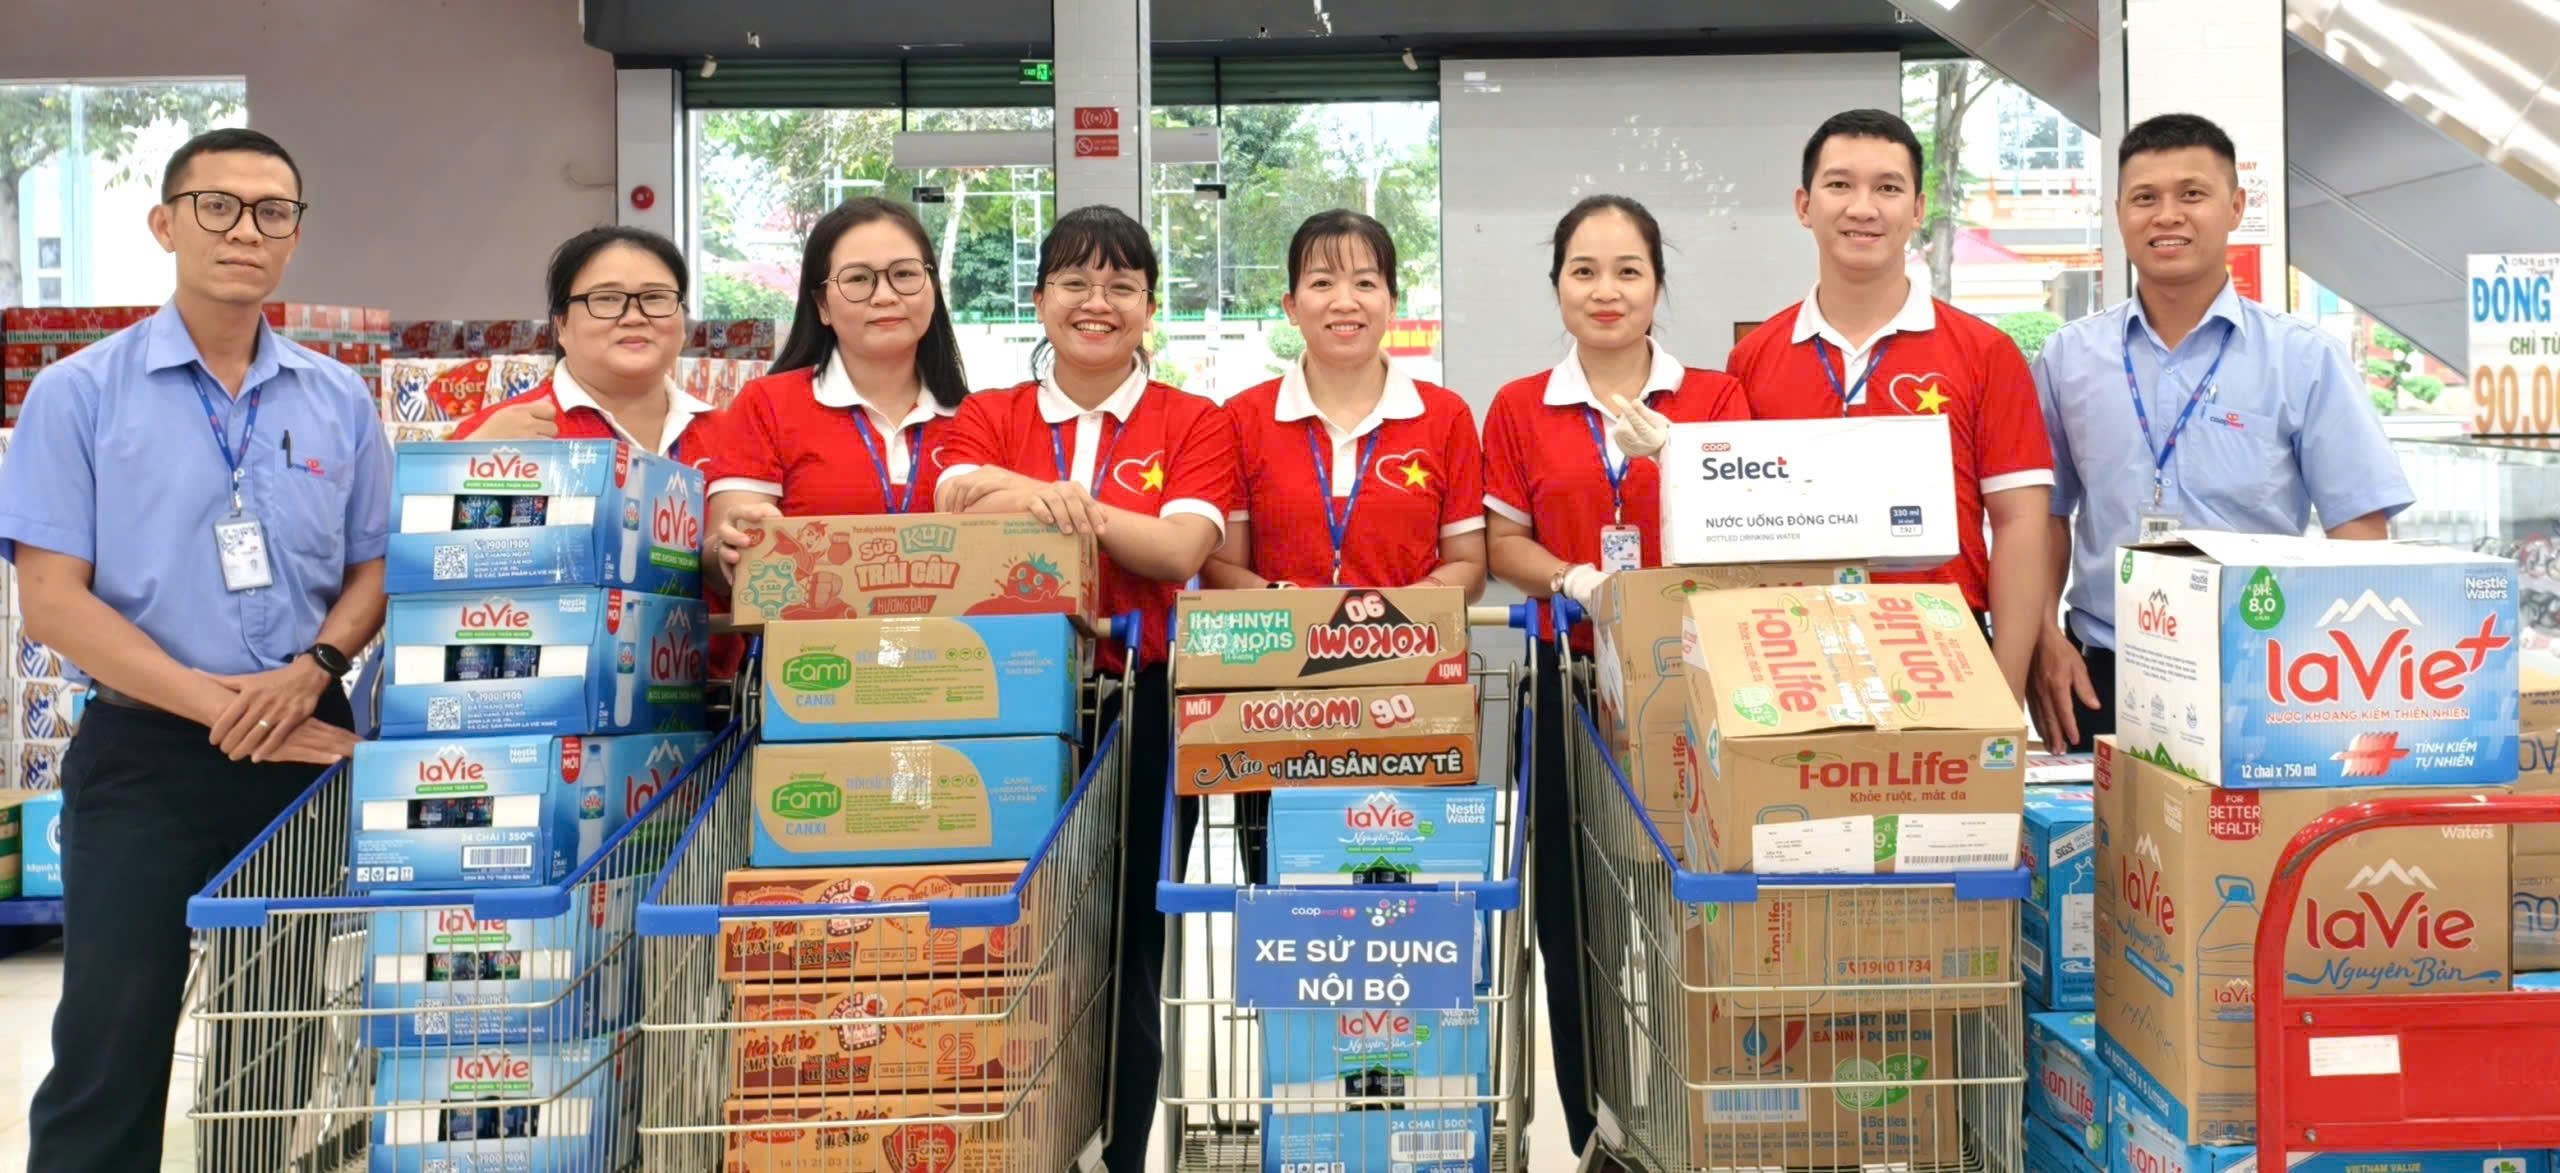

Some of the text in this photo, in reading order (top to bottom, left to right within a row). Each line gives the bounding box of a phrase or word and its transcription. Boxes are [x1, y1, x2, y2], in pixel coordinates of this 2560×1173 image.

[2472, 256, 2551, 323] ĐỒNG
[437, 377, 484, 400] Tiger
[2475, 364, 2560, 434] 90.0
[469, 452, 539, 479] laVie
[1702, 456, 1790, 481] Select
[652, 495, 698, 550] laVie
[1828, 513, 1858, 525] CHAI
[855, 555, 960, 591] TRÁI CÂY
[2465, 576, 2508, 589] Nestlé
[1345, 592, 1386, 622] 90
[2249, 597, 2277, 616] 8,0
[2465, 588, 2508, 601] Waters
[460, 602, 529, 629] laVie
[2138, 601, 2177, 637] laVie
[1308, 623, 1439, 658] KOKOMI
[795, 694, 836, 707] CANXI
[1240, 694, 1416, 732] KOKOMI 90
[419, 756, 485, 782] laVie
[1269, 759, 1281, 777] vị
[1287, 750, 1326, 778] HẢI
[1330, 748, 1378, 776] SẢN
[1381, 755, 1428, 774] CAY
[1888, 752, 1969, 786] Life
[2241, 762, 2317, 779] 12 chai x 750 ml
[2434, 754, 2475, 768] NHIÊN
[1446, 802, 1486, 815] Nestlé
[2208, 804, 2261, 819] BETTER
[2225, 795, 2244, 804] FOR
[785, 822, 827, 836] CANXI
[1345, 803, 1415, 829] laVie
[1446, 814, 1486, 825] Waters
[2208, 822, 2262, 836] HEALTH
[2441, 826, 2495, 840] Waters
[2055, 841, 2075, 860] SGS
[2121, 855, 2175, 935] laVie
[2306, 891, 2475, 950] laVie
[1255, 935, 1458, 968] XE SỬ DỤNG
[2318, 955, 2412, 991] Nguyên
[1298, 973, 1411, 1006] NỘI BỘ
[1339, 1009, 1410, 1037] laVe
[936, 1032, 976, 1065] 25
[1808, 1030, 1866, 1044] EADING
[456, 1054, 529, 1080] laVie
[1844, 1091, 1874, 1100] WAER
